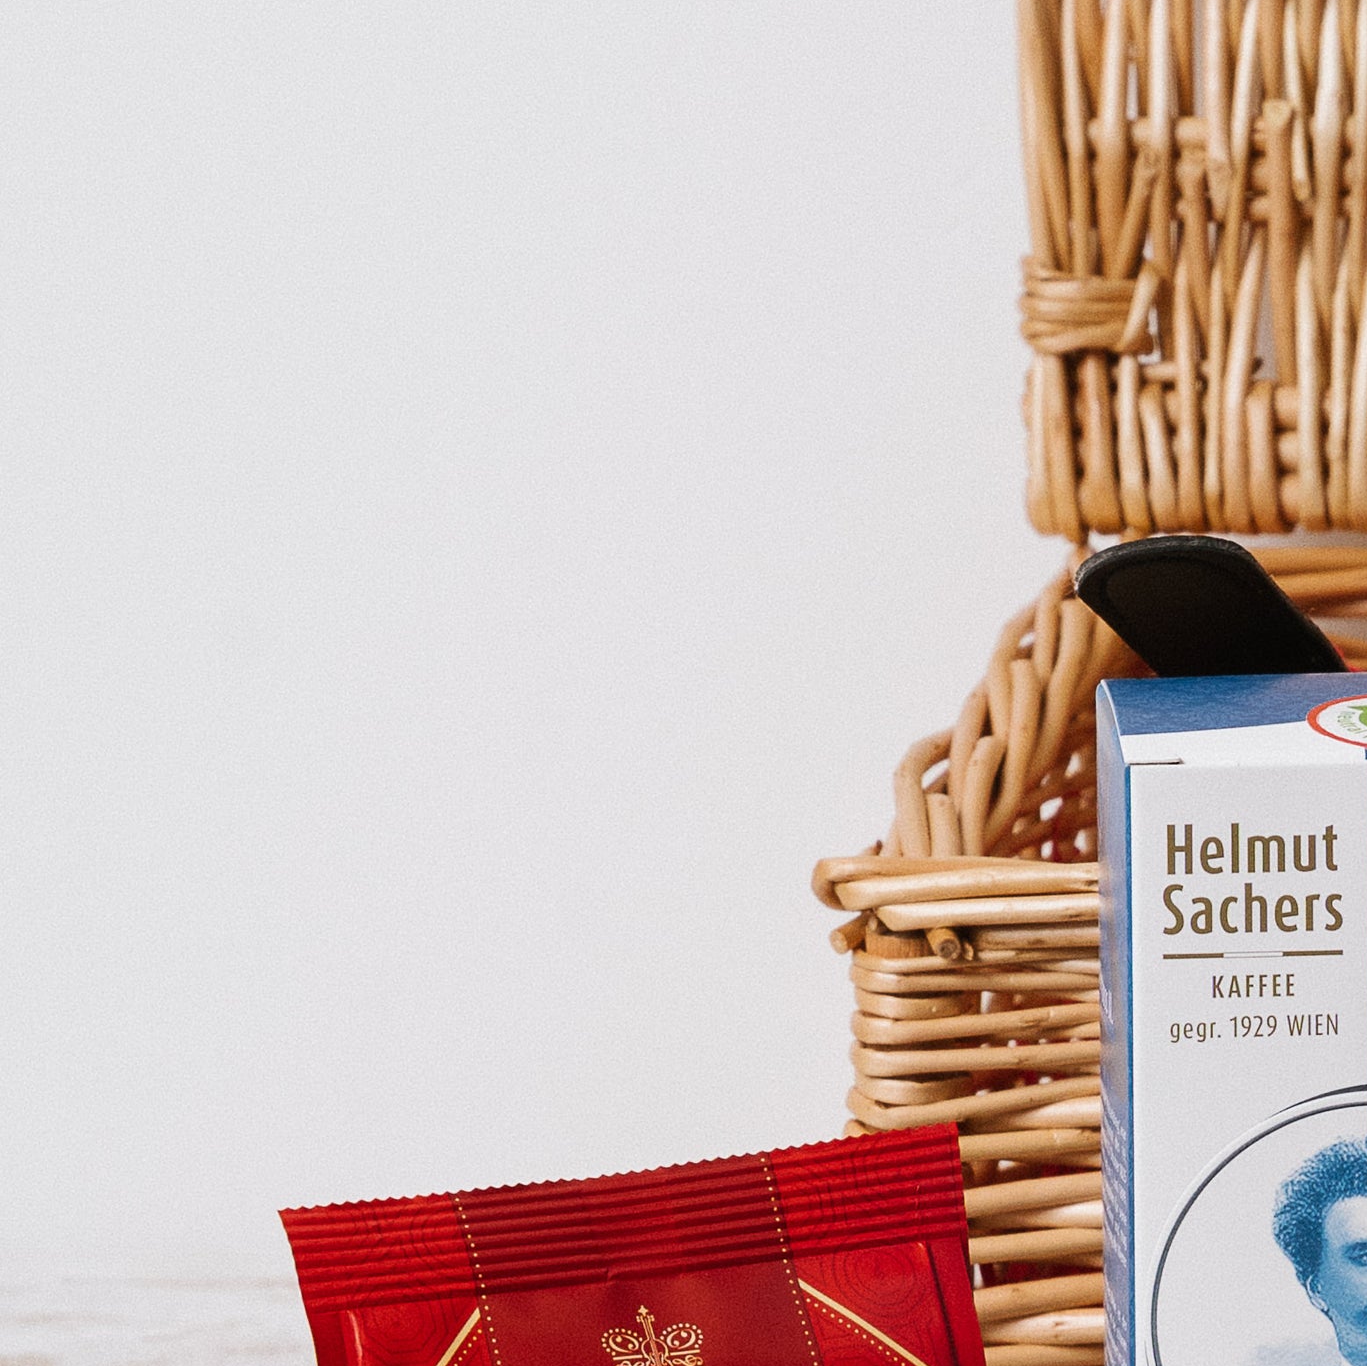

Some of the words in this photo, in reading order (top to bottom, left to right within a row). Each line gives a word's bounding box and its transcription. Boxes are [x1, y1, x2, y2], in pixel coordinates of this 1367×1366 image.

[1166, 822, 1338, 875] Helmut
[1162, 882, 1343, 935] Sachers
[1212, 974, 1295, 998] KAFFEE
[1170, 1021, 1221, 1043] gegr.
[1229, 1015, 1278, 1038] 1929
[1287, 1013, 1339, 1037] WIEN
